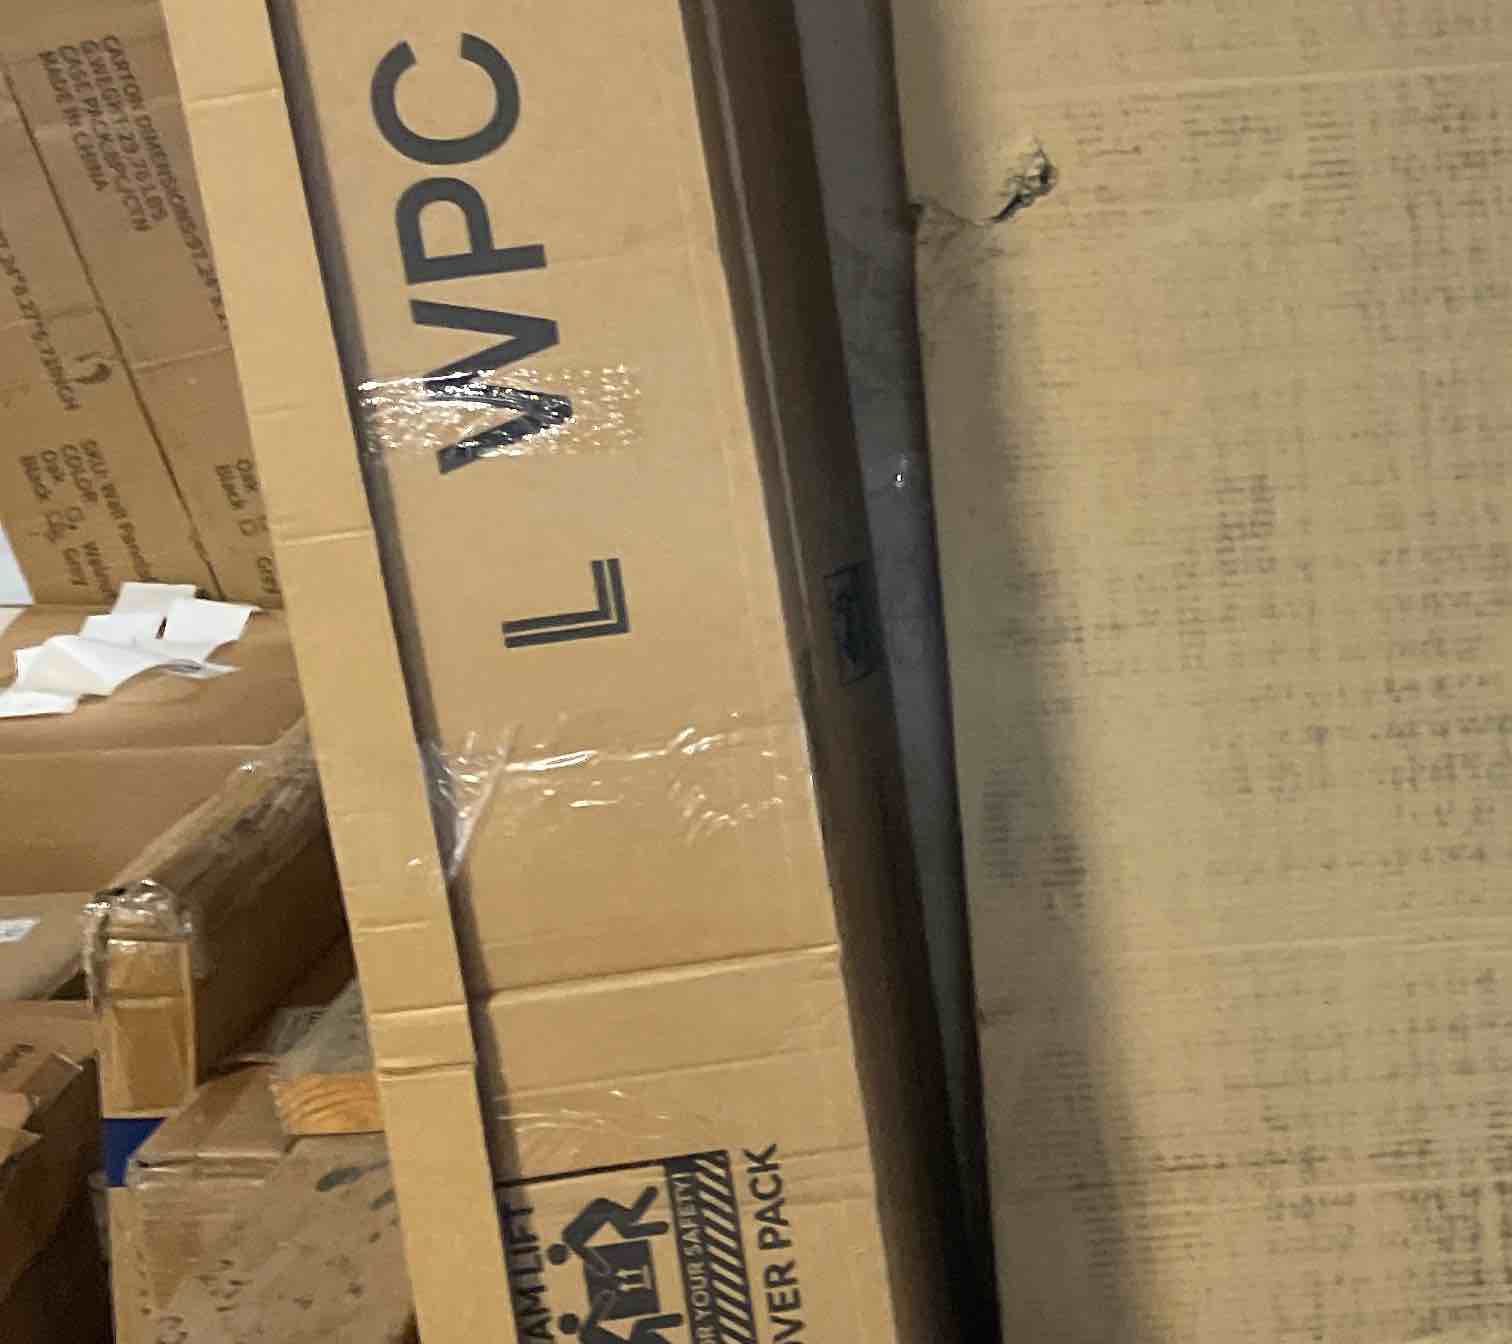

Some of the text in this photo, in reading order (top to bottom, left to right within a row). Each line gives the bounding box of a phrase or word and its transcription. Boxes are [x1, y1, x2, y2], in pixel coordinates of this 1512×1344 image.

[371, 32, 572, 475] WPC
[502, 1196, 545, 1277] LIFT
[743, 1143, 793, 1251] PACK
[684, 1261, 712, 1325] YOUR
